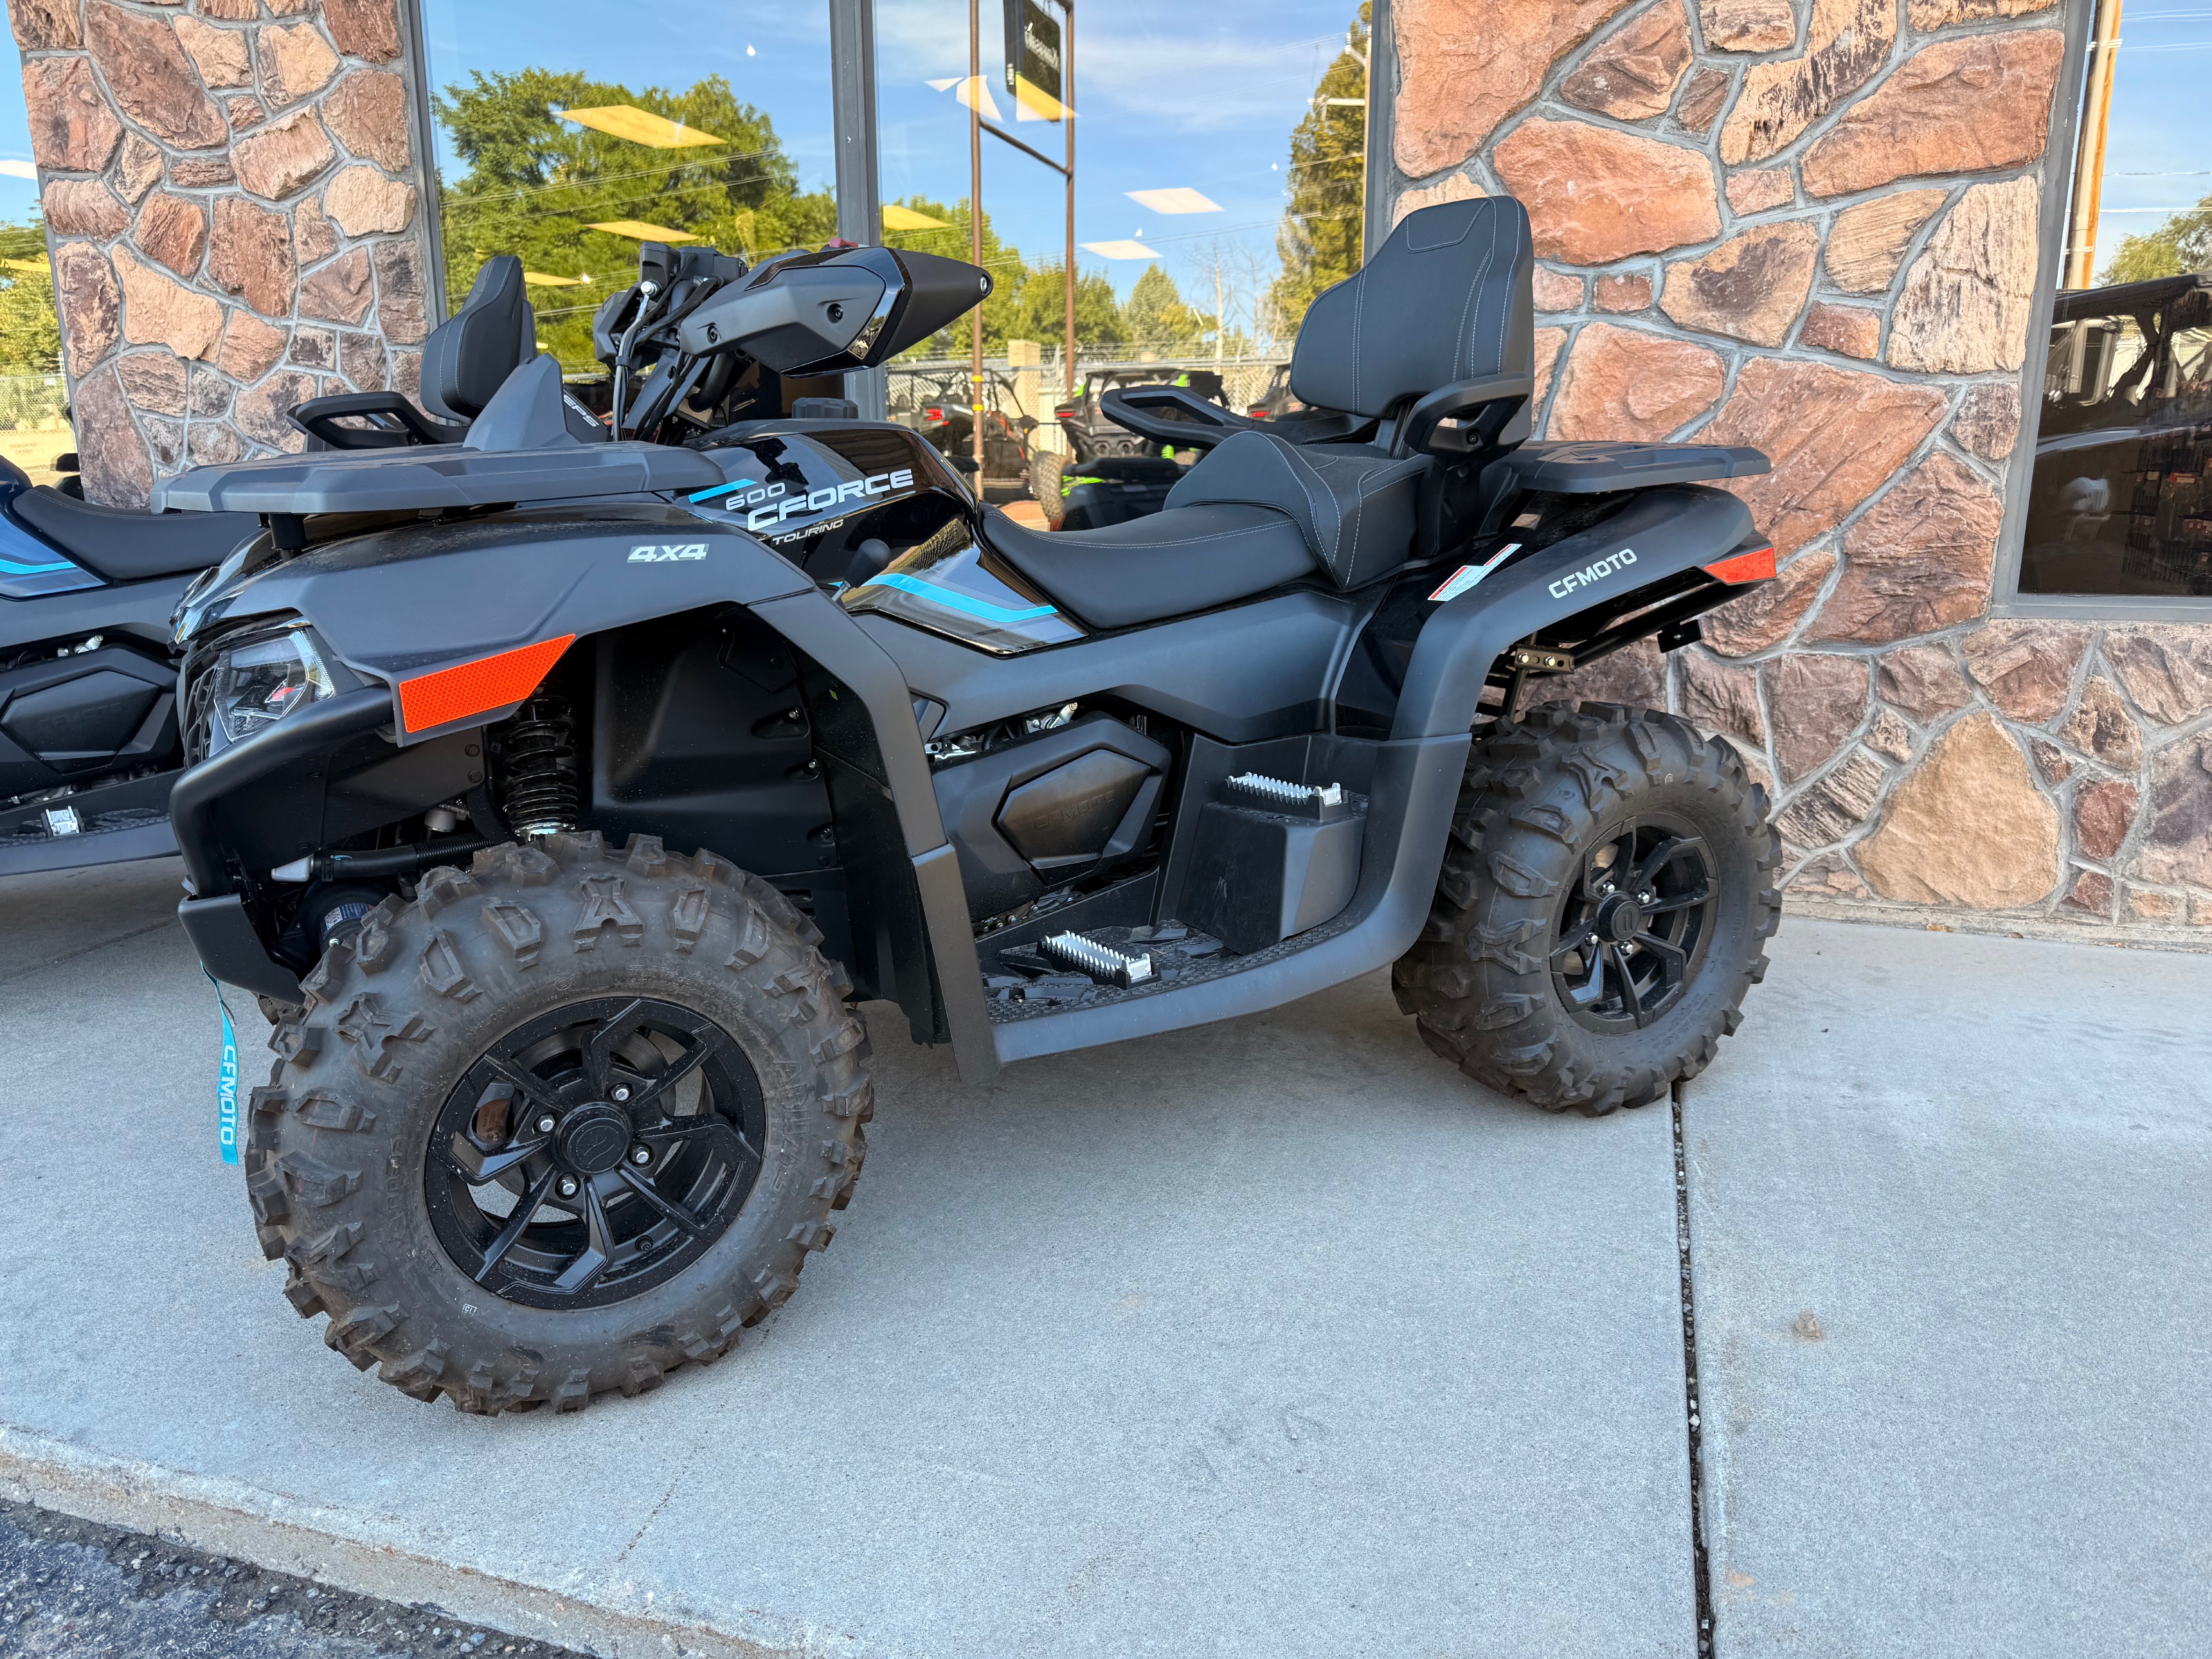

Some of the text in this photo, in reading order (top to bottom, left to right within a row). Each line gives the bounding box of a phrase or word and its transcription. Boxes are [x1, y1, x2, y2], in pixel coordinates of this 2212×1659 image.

[563, 394, 599, 427] EPS
[725, 482, 786, 510] 600
[748, 469, 914, 531] CFORCE
[772, 519, 844, 545] TOURING
[1548, 548, 1637, 599] CFMOTO
[1034, 790, 1117, 830] CFMOTO
[218, 1045, 236, 1145] CFMOTO
